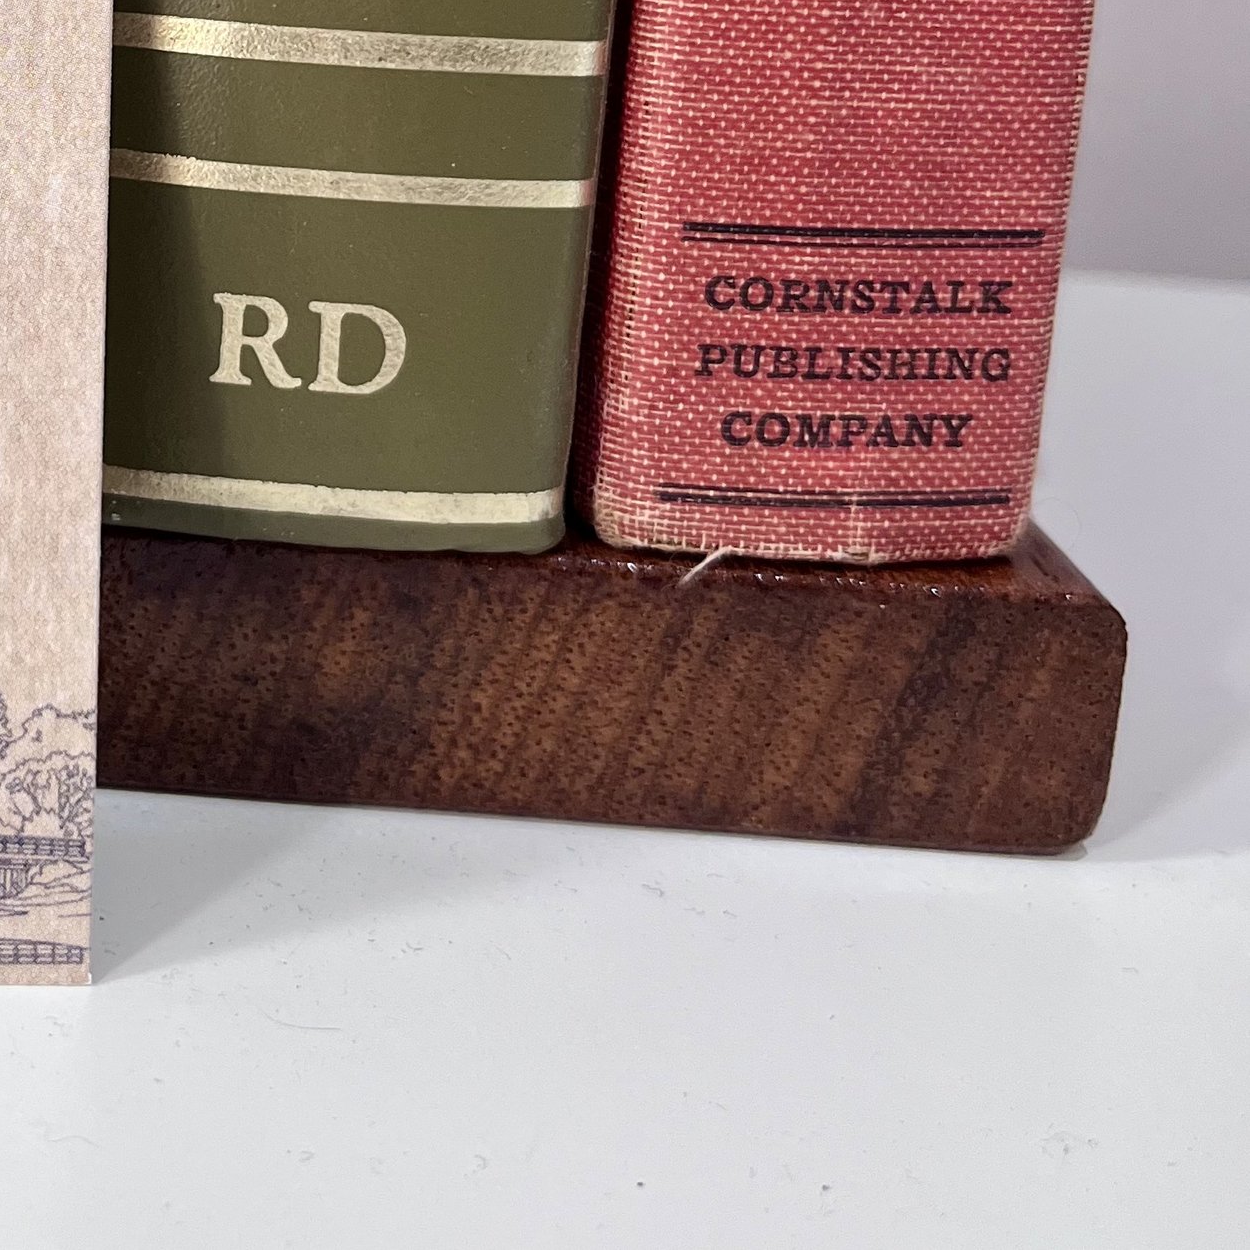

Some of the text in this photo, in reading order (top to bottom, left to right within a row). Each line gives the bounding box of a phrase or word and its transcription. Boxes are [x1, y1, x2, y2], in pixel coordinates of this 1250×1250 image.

[704, 275, 1013, 315] CORNSTALK
[209, 292, 407, 395] RD
[694, 343, 1011, 382] PUBLISHING
[720, 411, 975, 449] COMPANY
